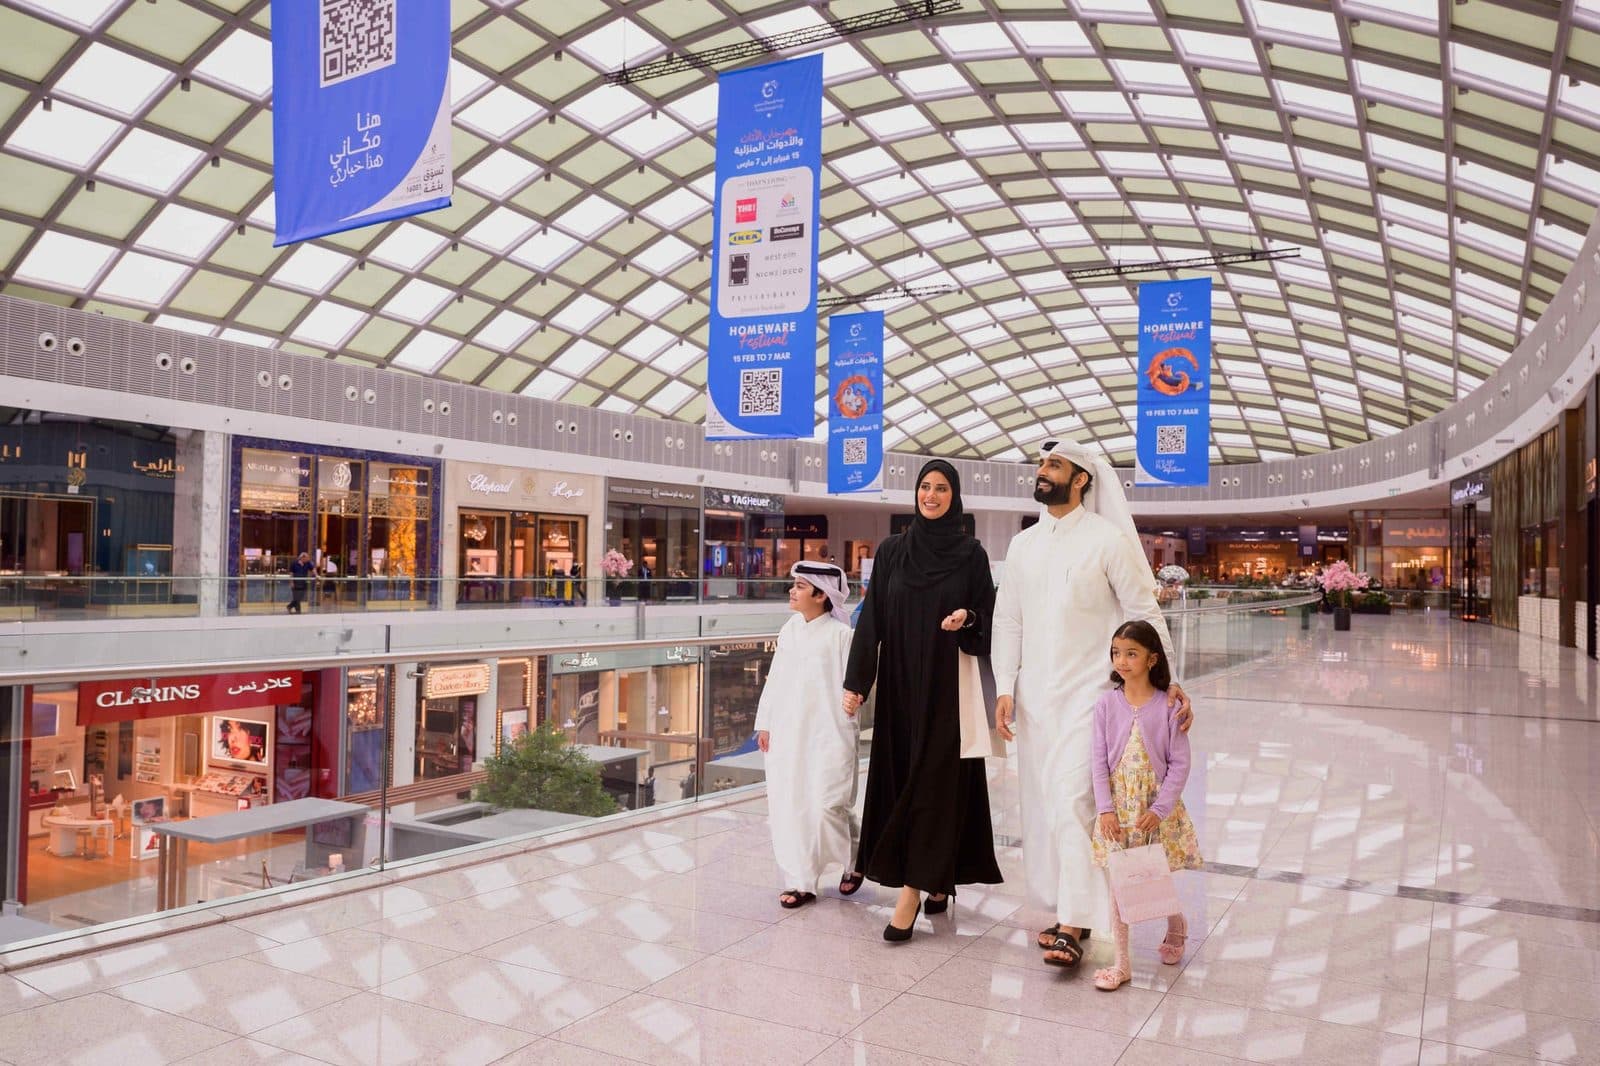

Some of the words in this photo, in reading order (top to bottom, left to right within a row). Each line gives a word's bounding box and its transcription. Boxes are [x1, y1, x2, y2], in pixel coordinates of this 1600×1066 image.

[357, 112, 381, 132] هنا
[329, 131, 381, 168] مكاني
[366, 152, 384, 170] هنا
[329, 159, 367, 187] خياري
[733, 233, 758, 241] IKEA
[729, 321, 797, 336] HOMEWARE
[1144, 321, 1204, 333] HOMEWARE
[733, 355, 741, 363] 15
[742, 354, 755, 362] FEB
[773, 351, 791, 360] MAR
[467, 473, 514, 495] Chopard
[569, 656, 599, 668] OEGA
[96, 684, 201, 708] CLARINS
